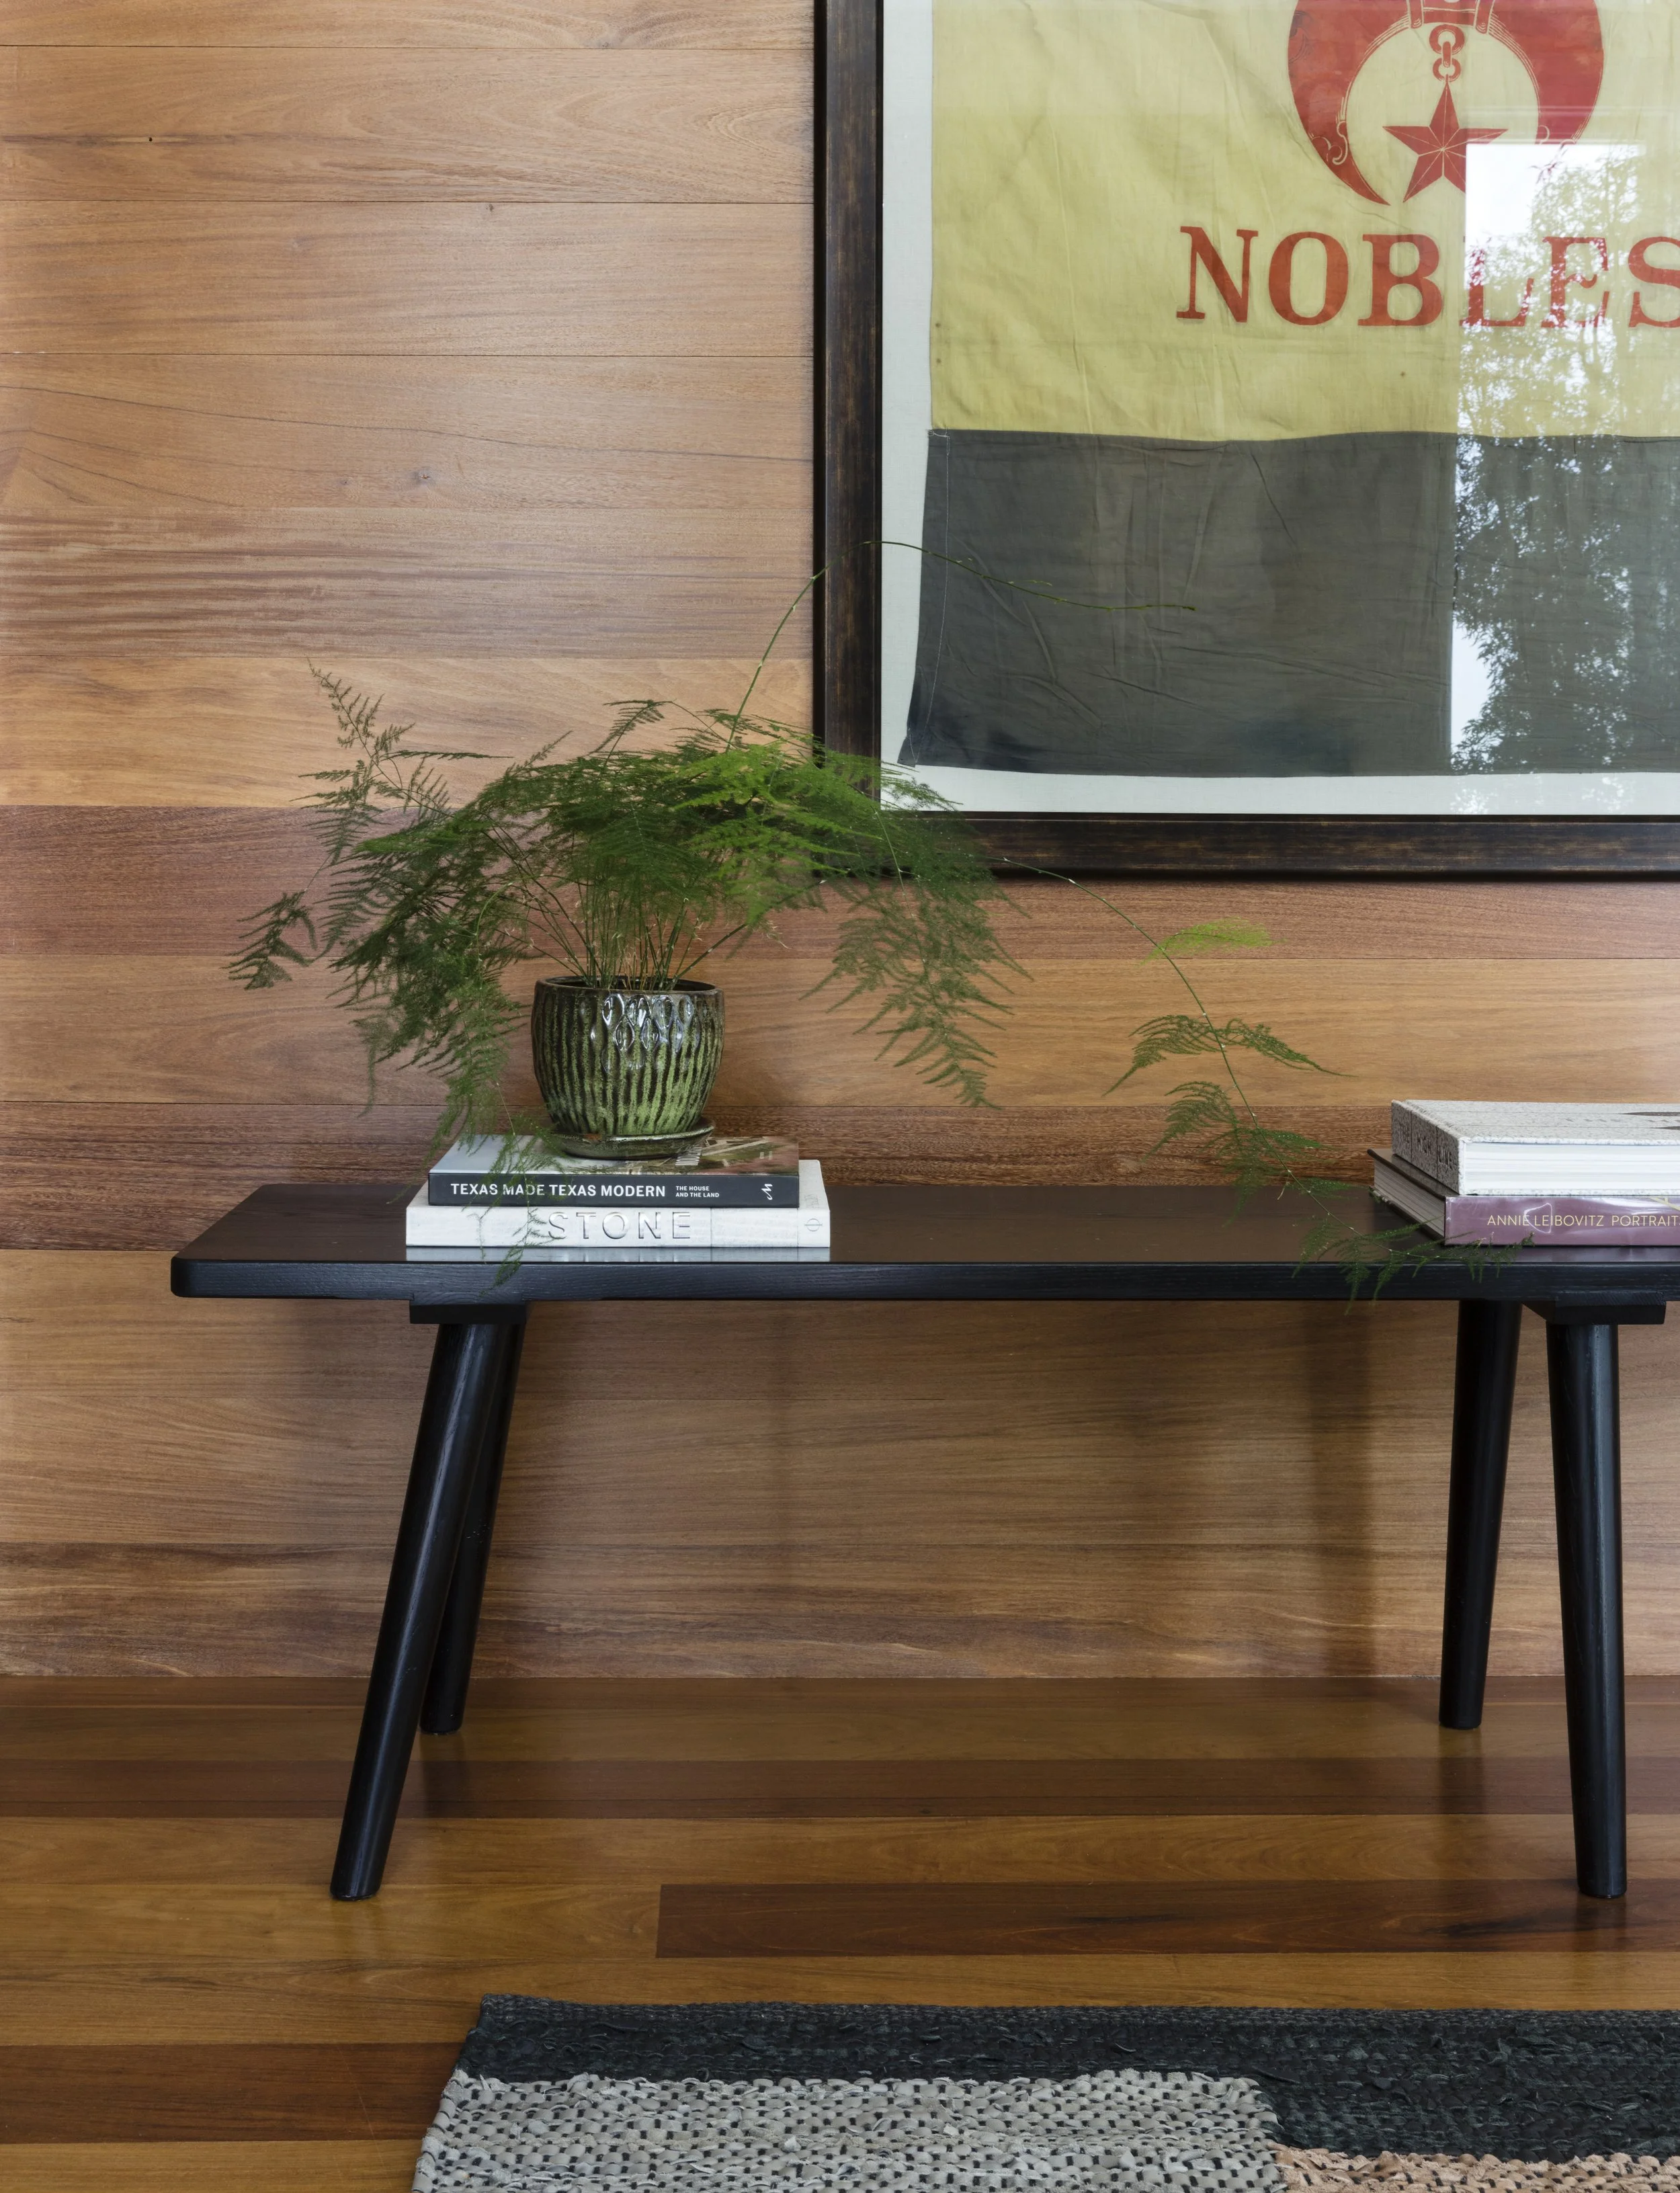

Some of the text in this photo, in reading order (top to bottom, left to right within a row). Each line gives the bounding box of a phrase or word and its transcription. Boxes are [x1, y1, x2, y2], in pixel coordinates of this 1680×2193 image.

[1176, 226, 1680, 328] NOBLES
[450, 1183, 666, 1197] TEXAS MADE TEXAS MODERN
[548, 1211, 690, 1239] STONE
[1487, 1214, 1680, 1227] ANNIE LEIBOVITZ PORTRAIT
